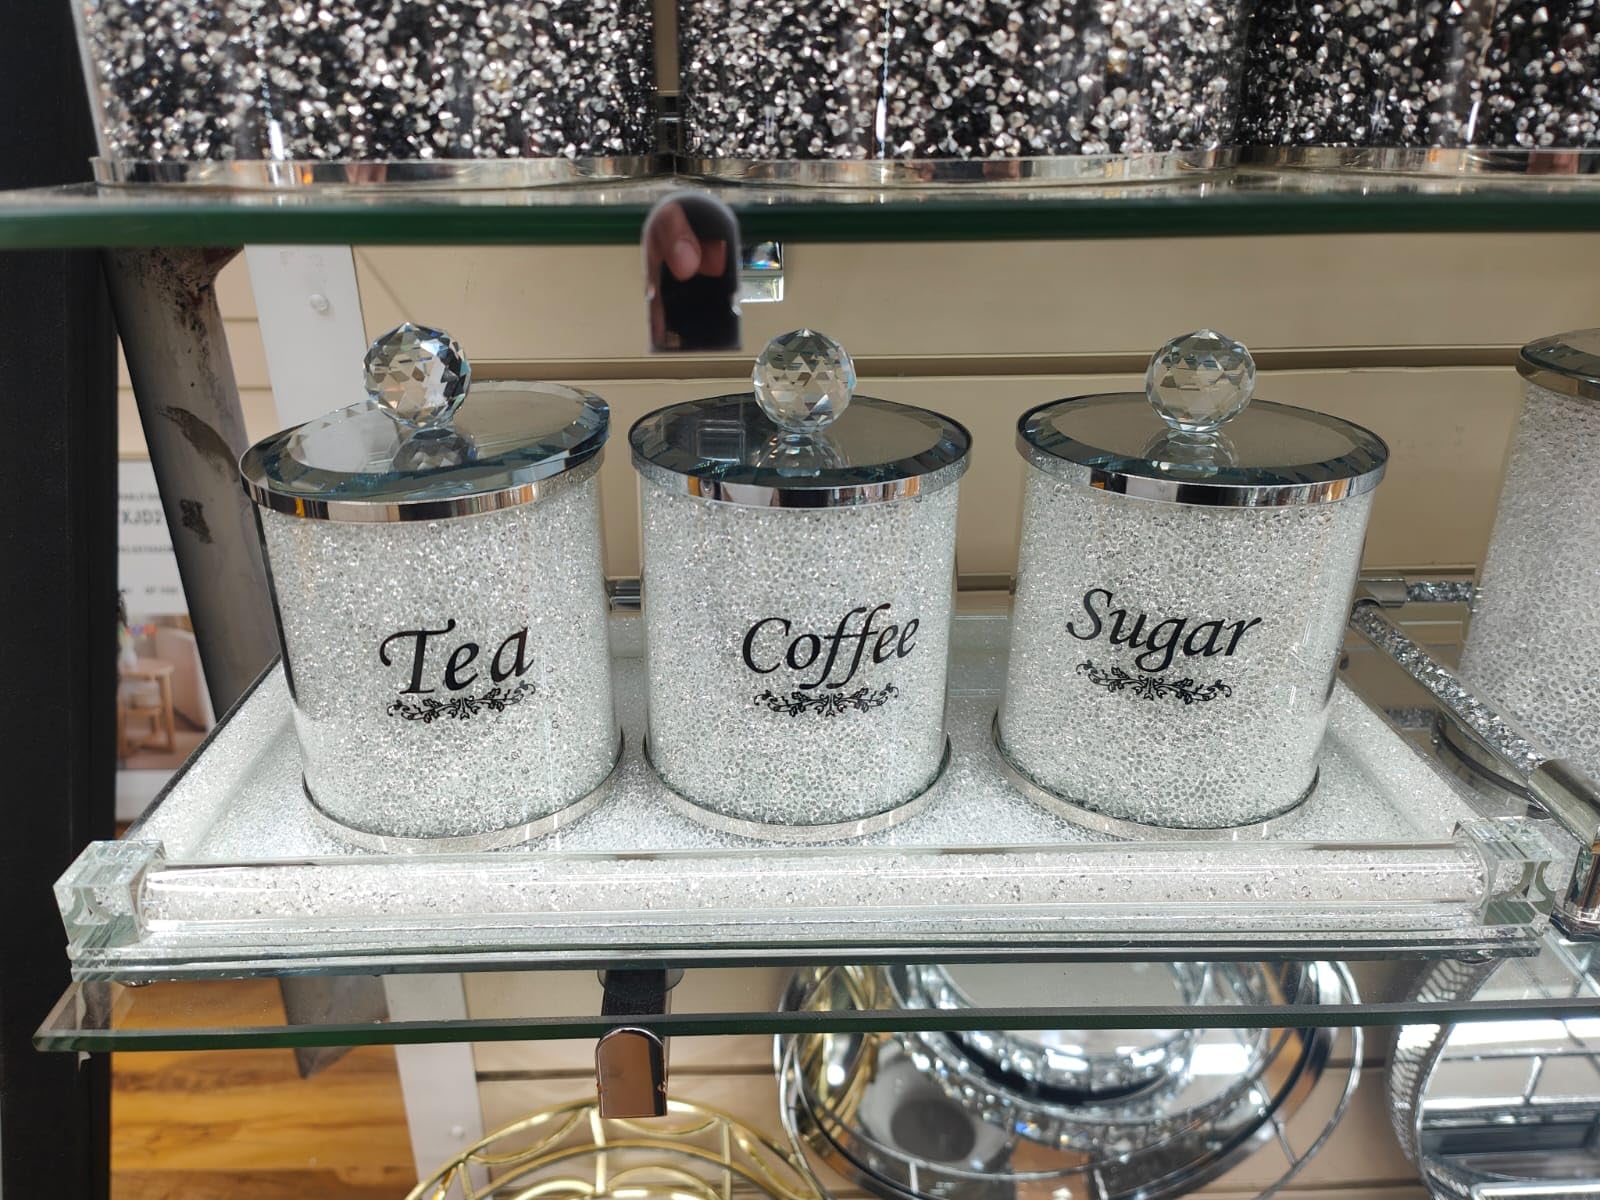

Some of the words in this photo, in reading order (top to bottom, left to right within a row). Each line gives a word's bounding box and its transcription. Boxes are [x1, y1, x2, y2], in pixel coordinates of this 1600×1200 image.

[380, 618, 535, 695] Tea
[742, 603, 920, 690] Coffee
[1066, 588, 1262, 672] Sugar
